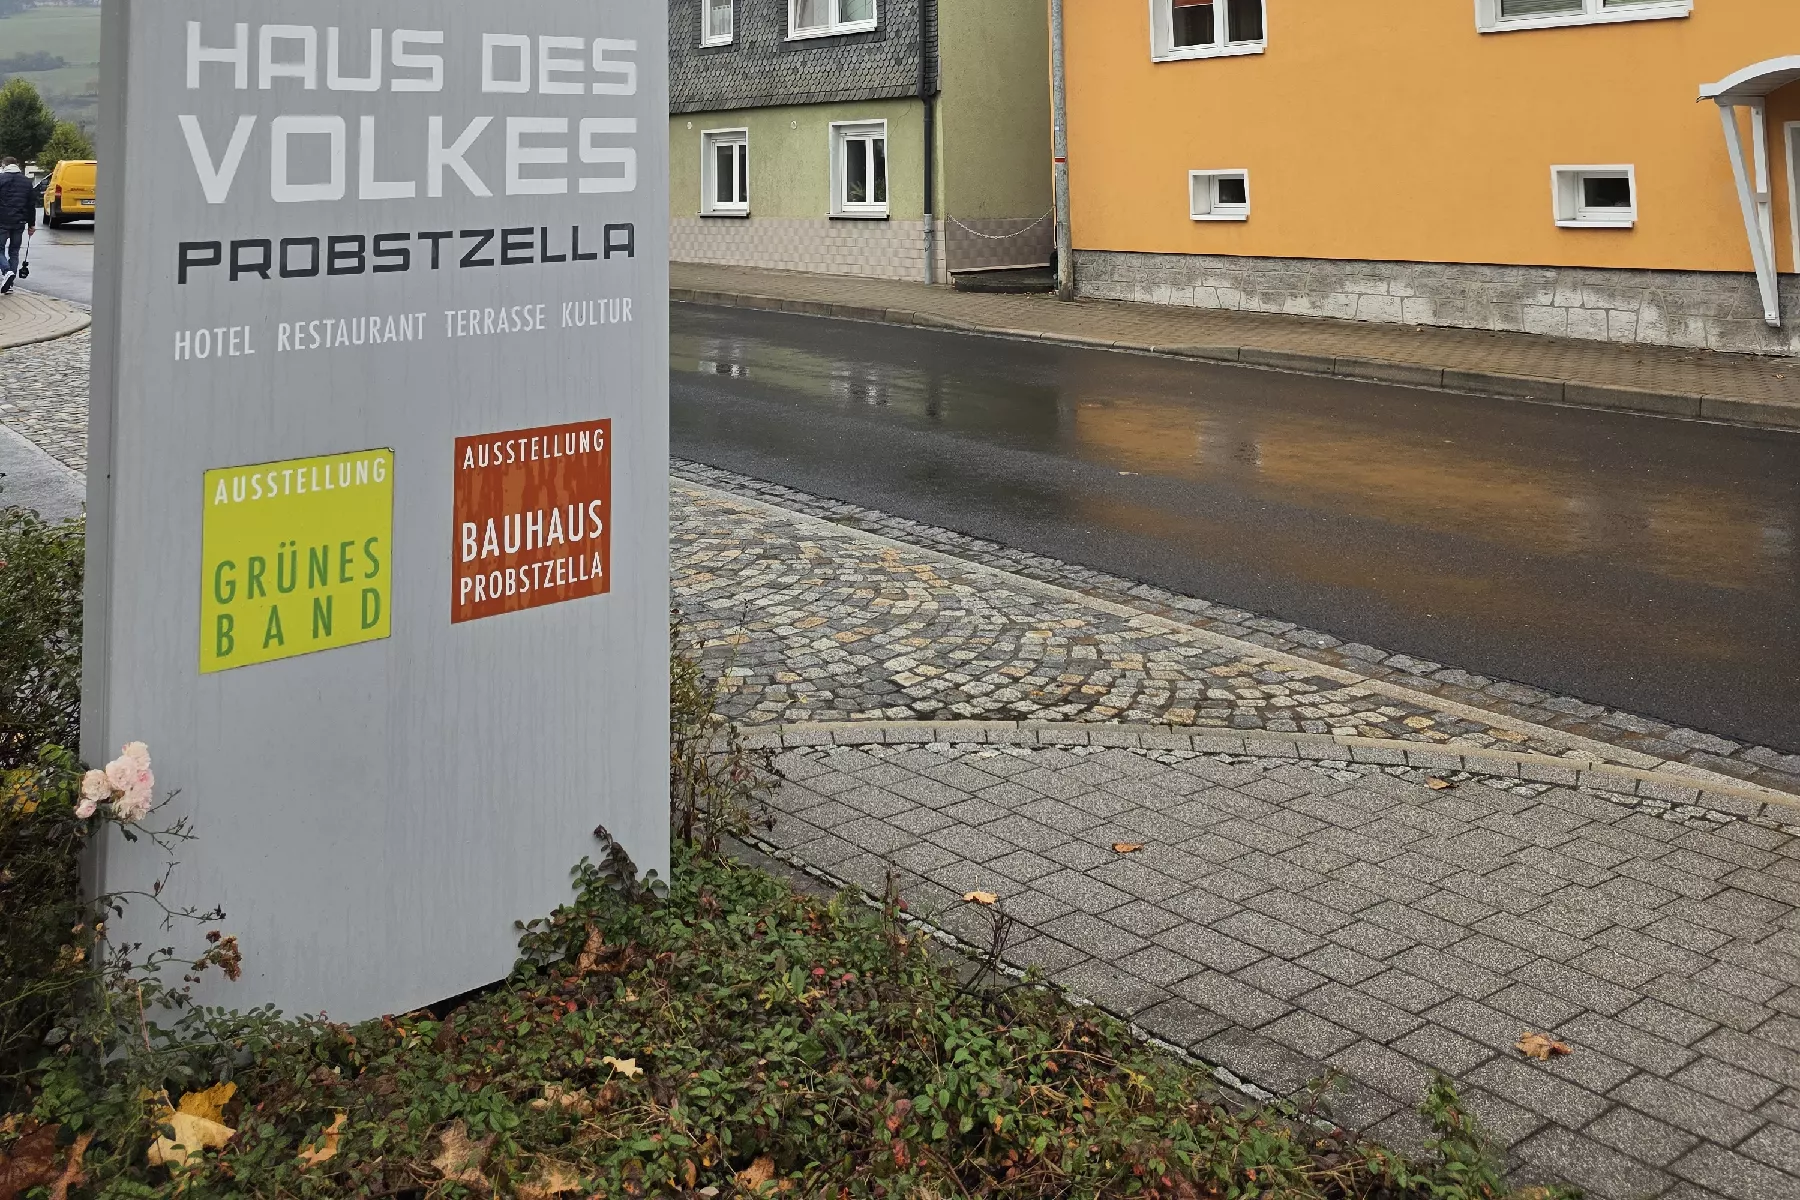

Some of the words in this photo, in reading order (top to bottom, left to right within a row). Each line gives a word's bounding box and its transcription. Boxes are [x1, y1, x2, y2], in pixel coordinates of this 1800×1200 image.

[186, 21, 443, 91] HAUS
[481, 33, 636, 95] DES
[178, 115, 636, 203] VOLKES
[177, 223, 634, 284] PROBSTZELLA
[174, 326, 254, 359] HOTEL
[277, 313, 425, 351] RESTAURANT
[444, 304, 545, 337] TERRASSE
[561, 297, 633, 327] KULTUR
[462, 428, 604, 470] AUSSTELLUNG
[213, 457, 386, 505] AUSSTELLUNG
[461, 499, 603, 562] BAUHAUS
[213, 536, 380, 604] GRÜNES
[459, 551, 603, 605] PROBSTZELLA
[215, 587, 381, 657] BAND
